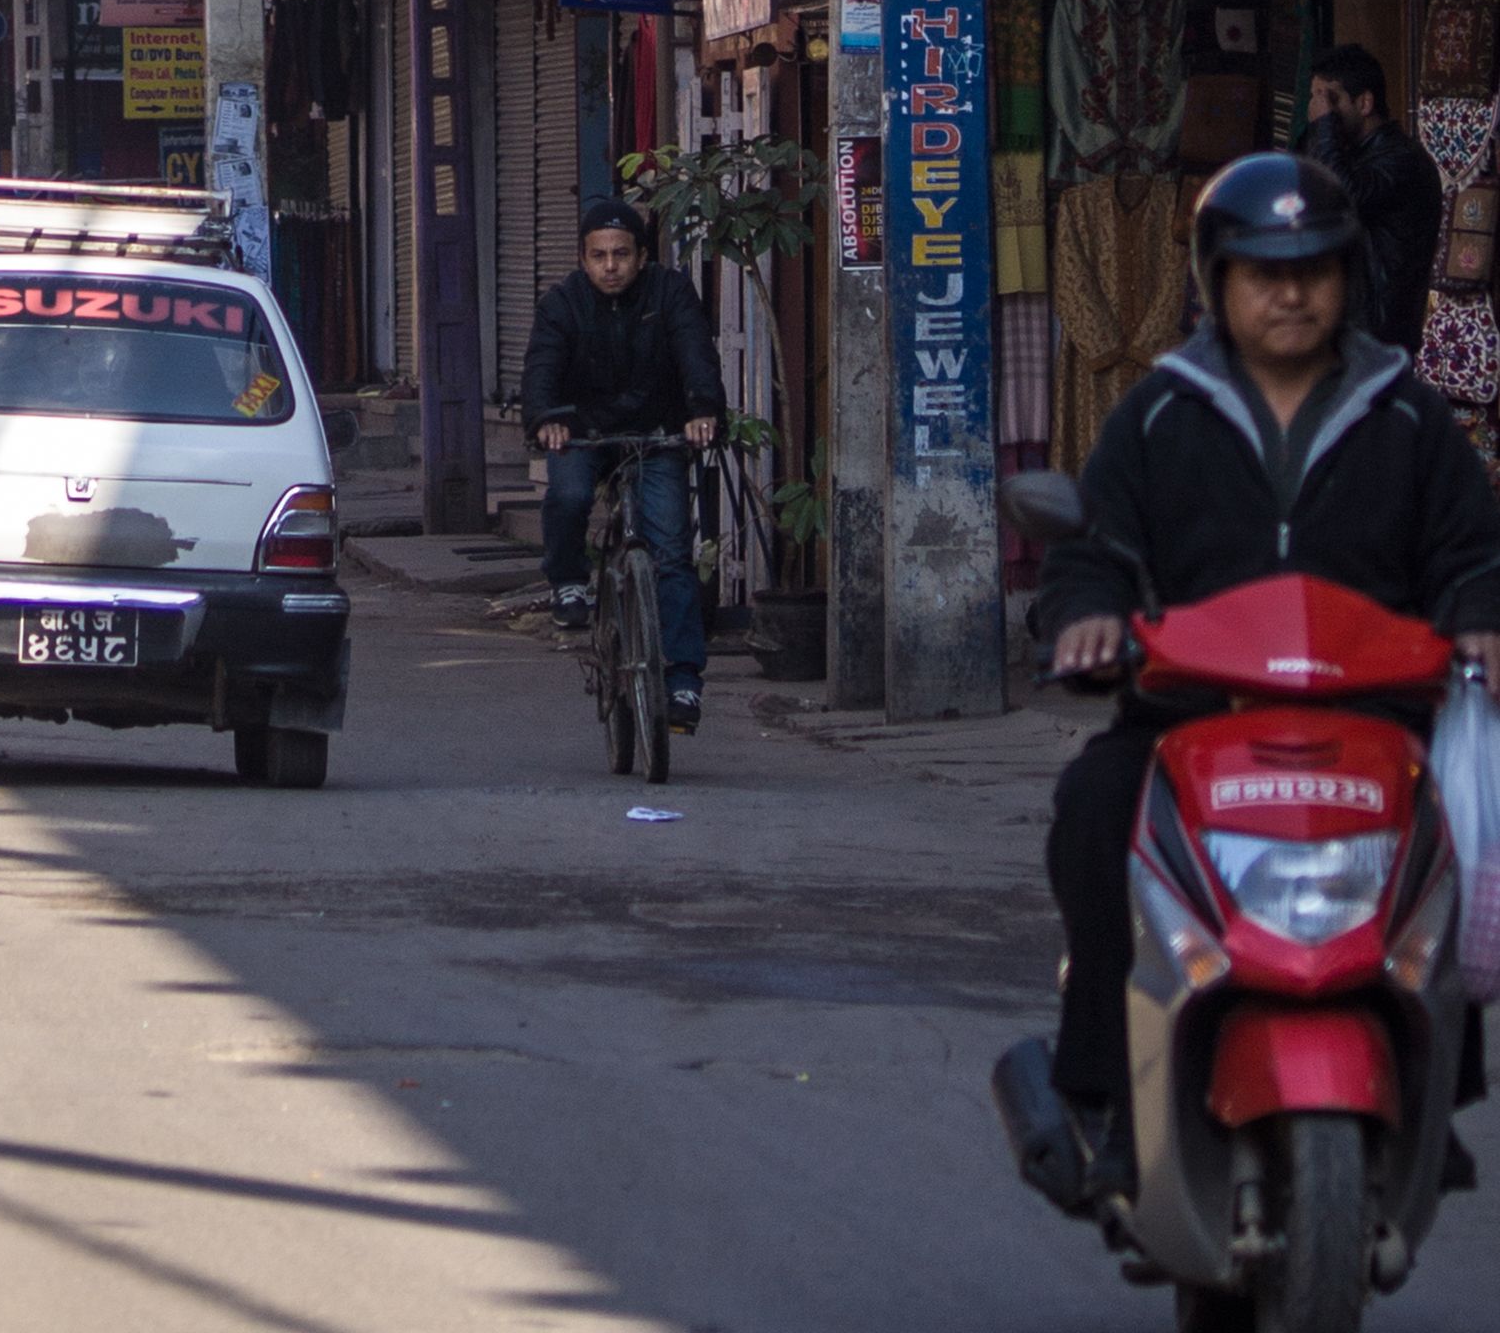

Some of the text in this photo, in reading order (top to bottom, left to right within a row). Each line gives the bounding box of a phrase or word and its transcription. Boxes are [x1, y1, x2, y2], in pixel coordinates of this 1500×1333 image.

[130, 32, 201, 46] Internet,
[130, 48, 172, 62] CD/DVD
[130, 86, 169, 102] Computer
[839, 139, 859, 261] ABSOLUTION
[909, 159, 963, 266] EYE
[235, 374, 279, 417] TAXI
[28, 633, 127, 663] ४६५८
